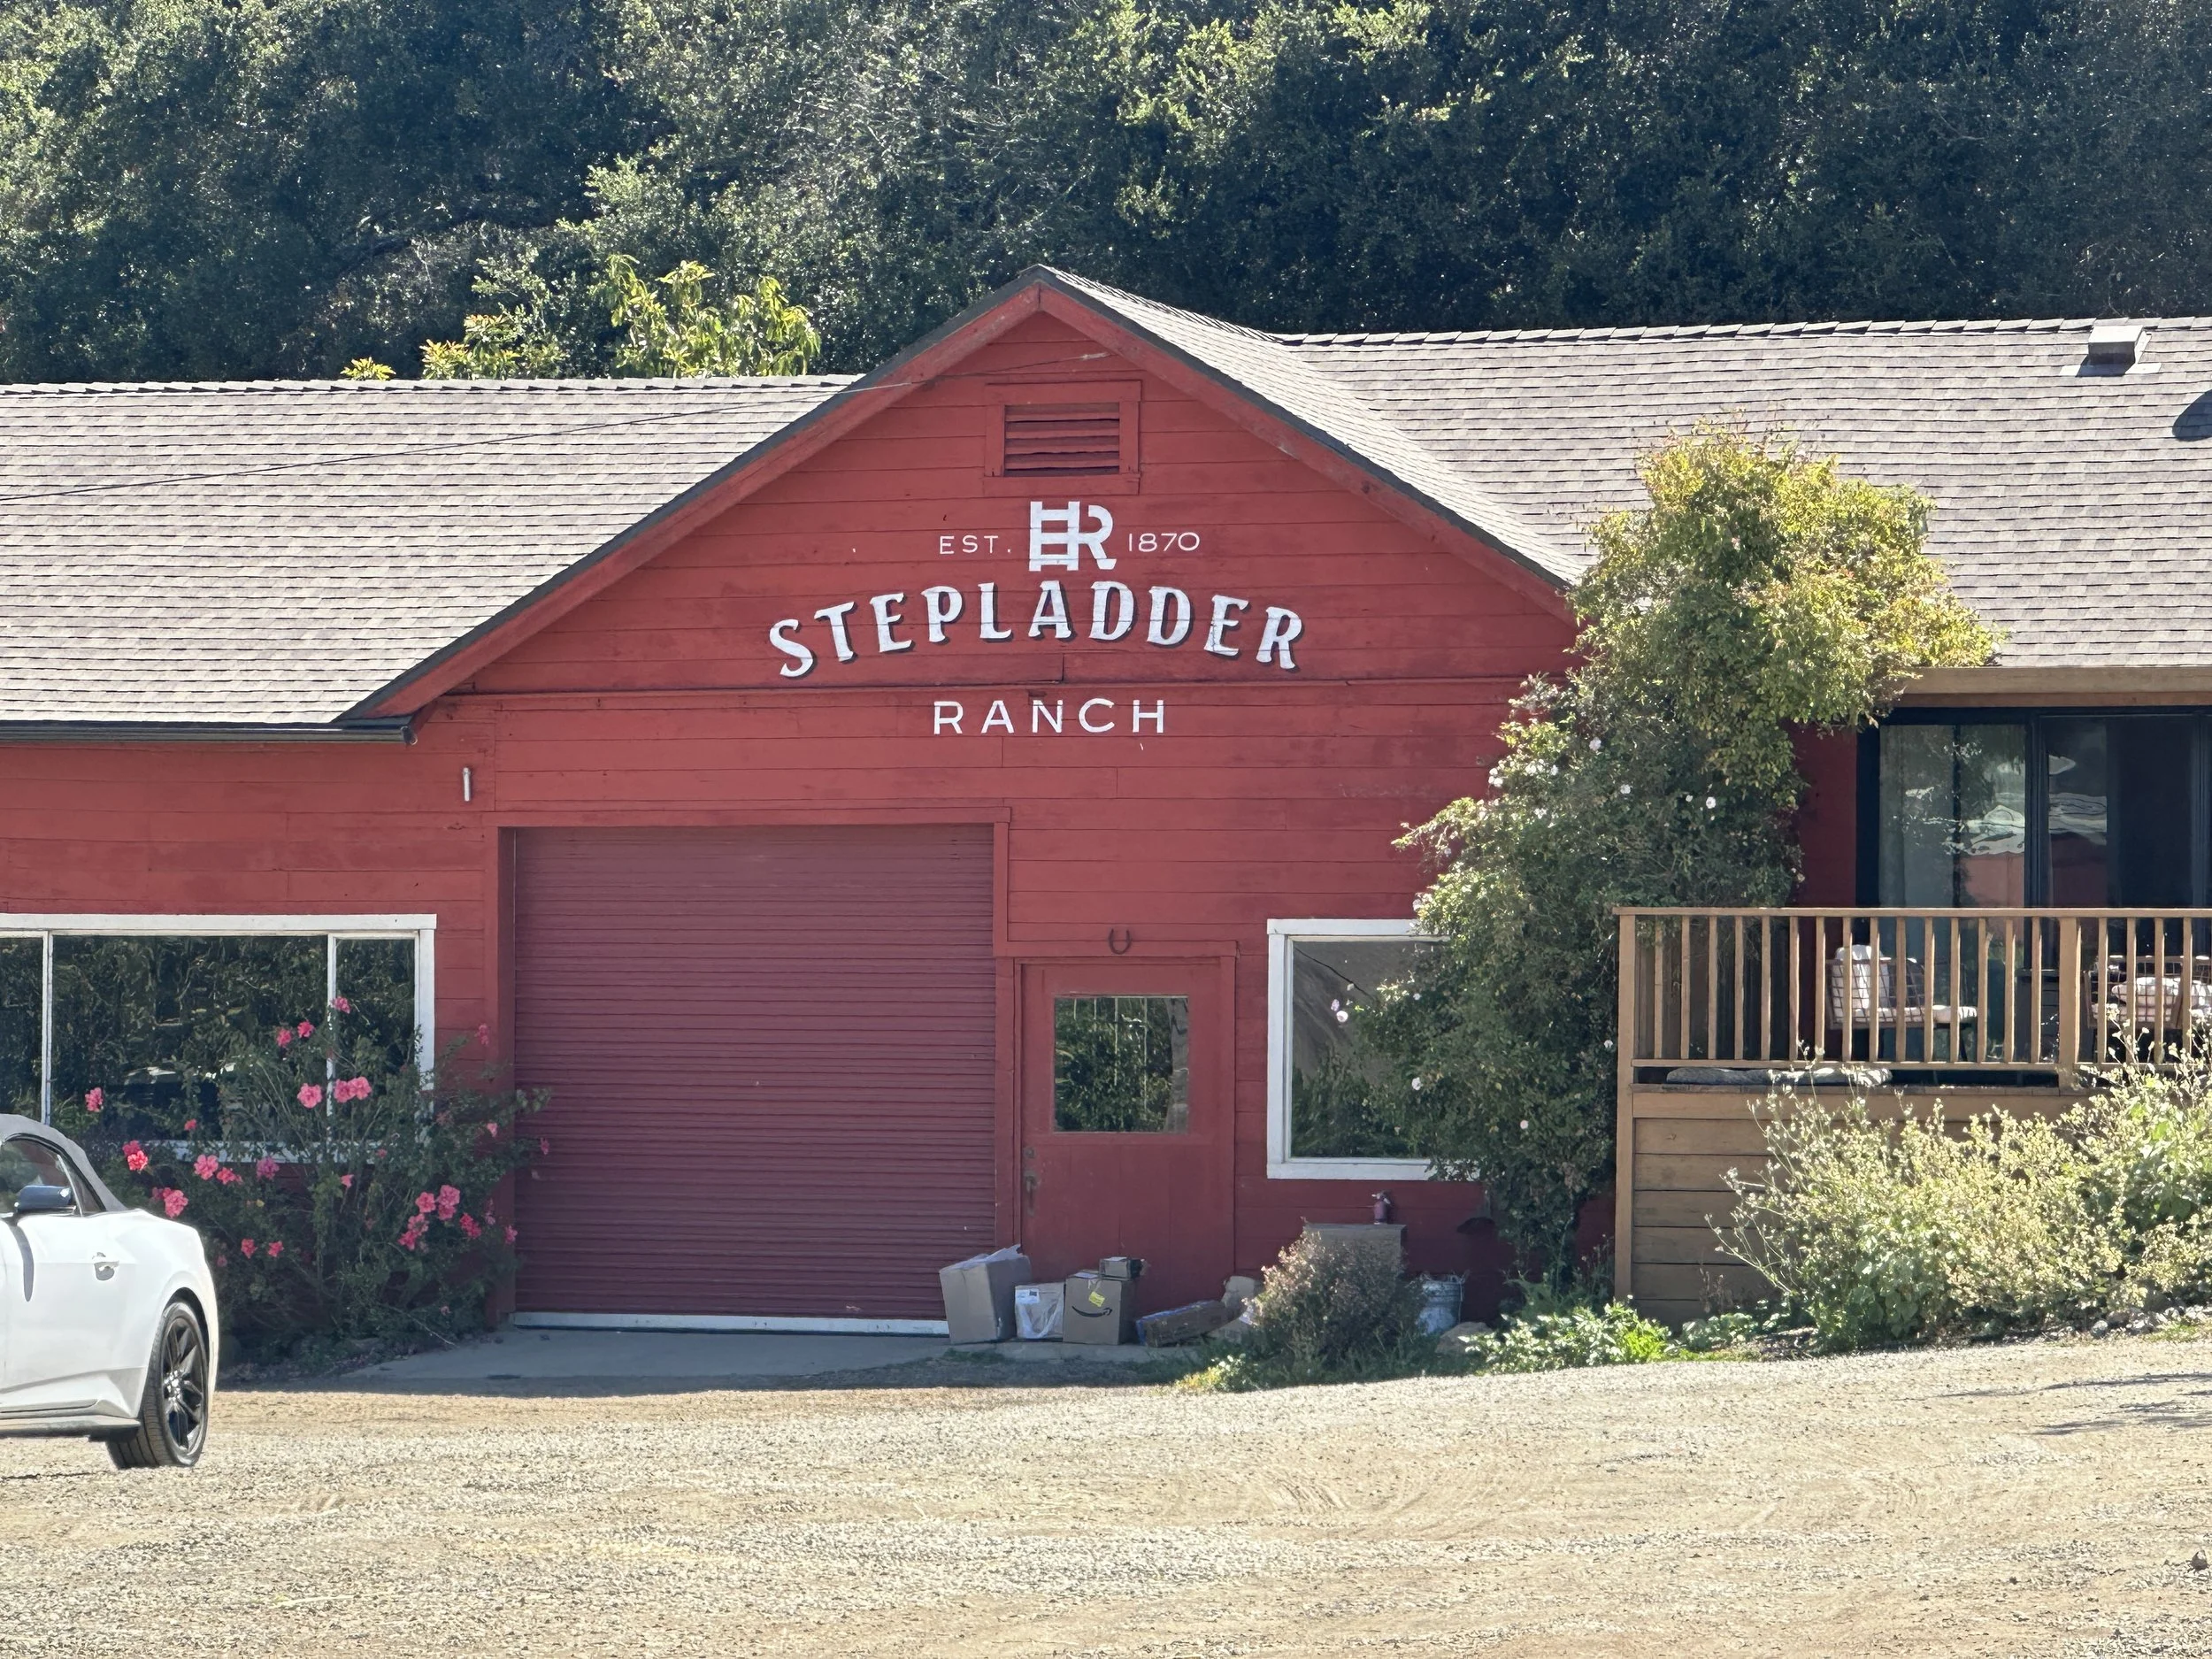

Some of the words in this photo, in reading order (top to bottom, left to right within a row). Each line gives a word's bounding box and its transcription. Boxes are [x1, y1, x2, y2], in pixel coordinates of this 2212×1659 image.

[939, 534, 1012, 555] EST.
[1128, 531, 1201, 553] 1870
[769, 580, 1303, 680] STEPLADDER
[933, 697, 1165, 735] RANCH
